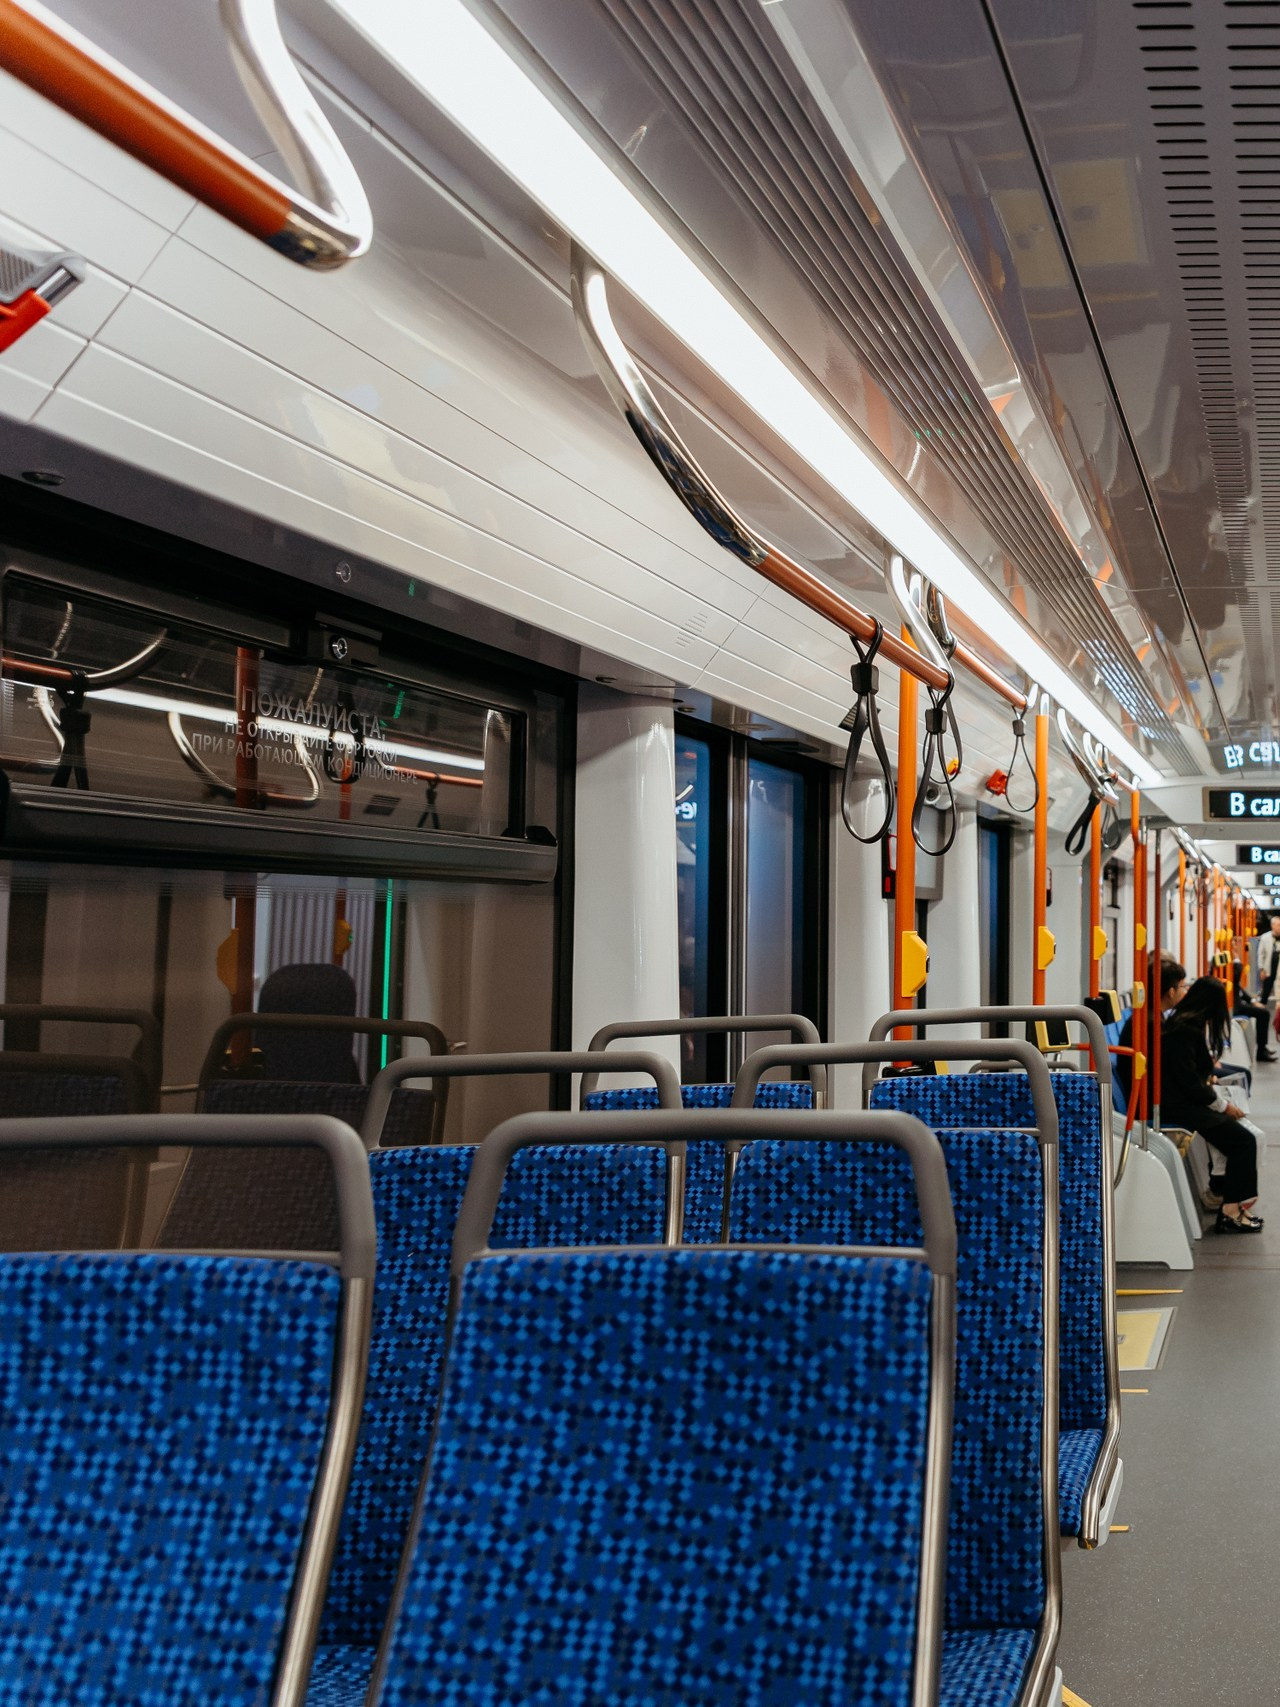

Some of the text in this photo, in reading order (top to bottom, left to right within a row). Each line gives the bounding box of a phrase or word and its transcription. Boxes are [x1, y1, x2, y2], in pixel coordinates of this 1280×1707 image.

[241, 685, 386, 741] ПОЖАЛУЙСТА,
[225, 716, 244, 736] НЕ
[192, 733, 418, 784] ПРИ РАБОТАЮЩЕМ КОНДИЦИОНЕРЕ
[1230, 792, 1246, 816] В
[1251, 847, 1262, 862] В
